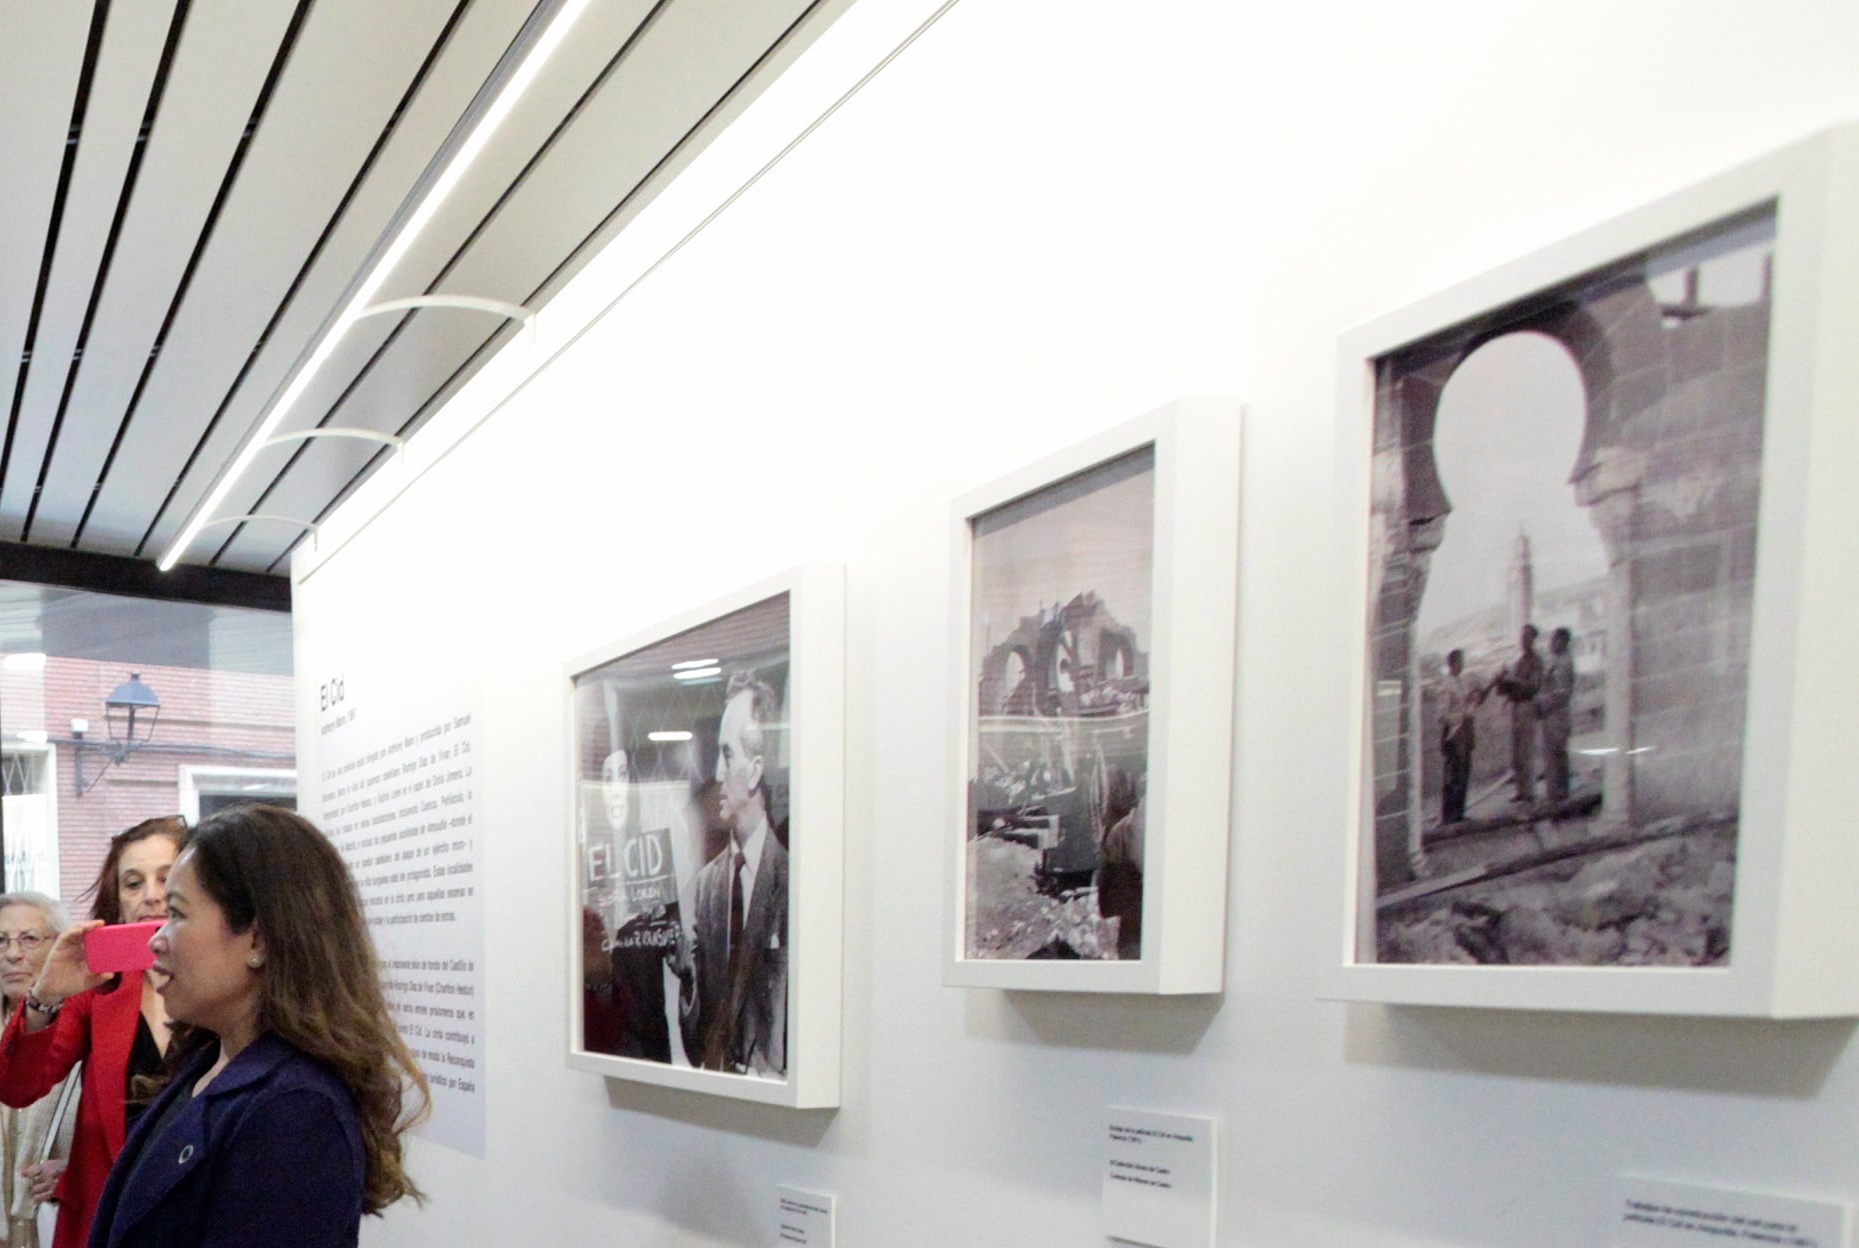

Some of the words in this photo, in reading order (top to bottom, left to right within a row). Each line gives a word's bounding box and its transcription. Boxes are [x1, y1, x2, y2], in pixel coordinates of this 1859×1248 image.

[320, 684, 329, 712] El
[330, 673, 345, 706] Cid
[589, 843, 622, 882] EL
[623, 835, 663, 878] CID
